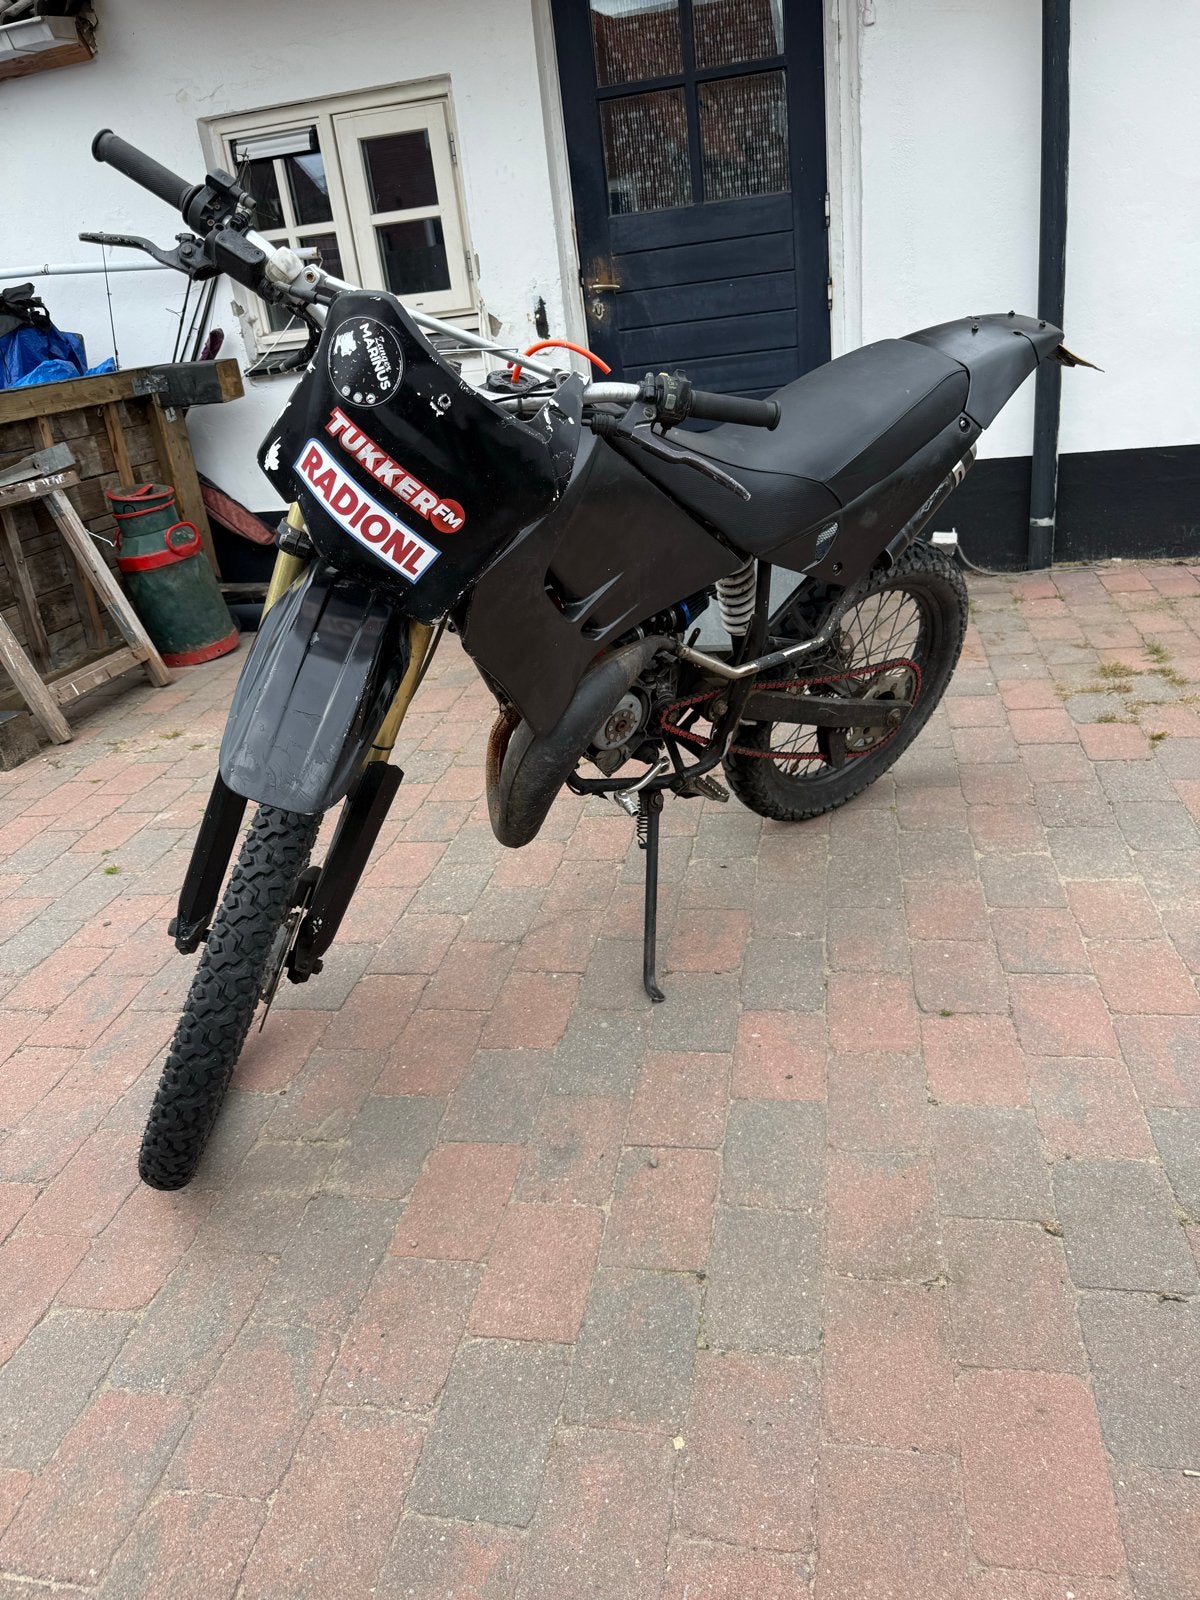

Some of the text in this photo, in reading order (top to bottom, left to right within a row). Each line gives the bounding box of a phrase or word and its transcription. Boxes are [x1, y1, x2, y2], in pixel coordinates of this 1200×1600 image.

[360, 323, 391, 391] MARINUS
[375, 336, 391, 372] Zanger
[329, 412, 439, 515] TUKKER
[301, 445, 427, 576] RADIONL
